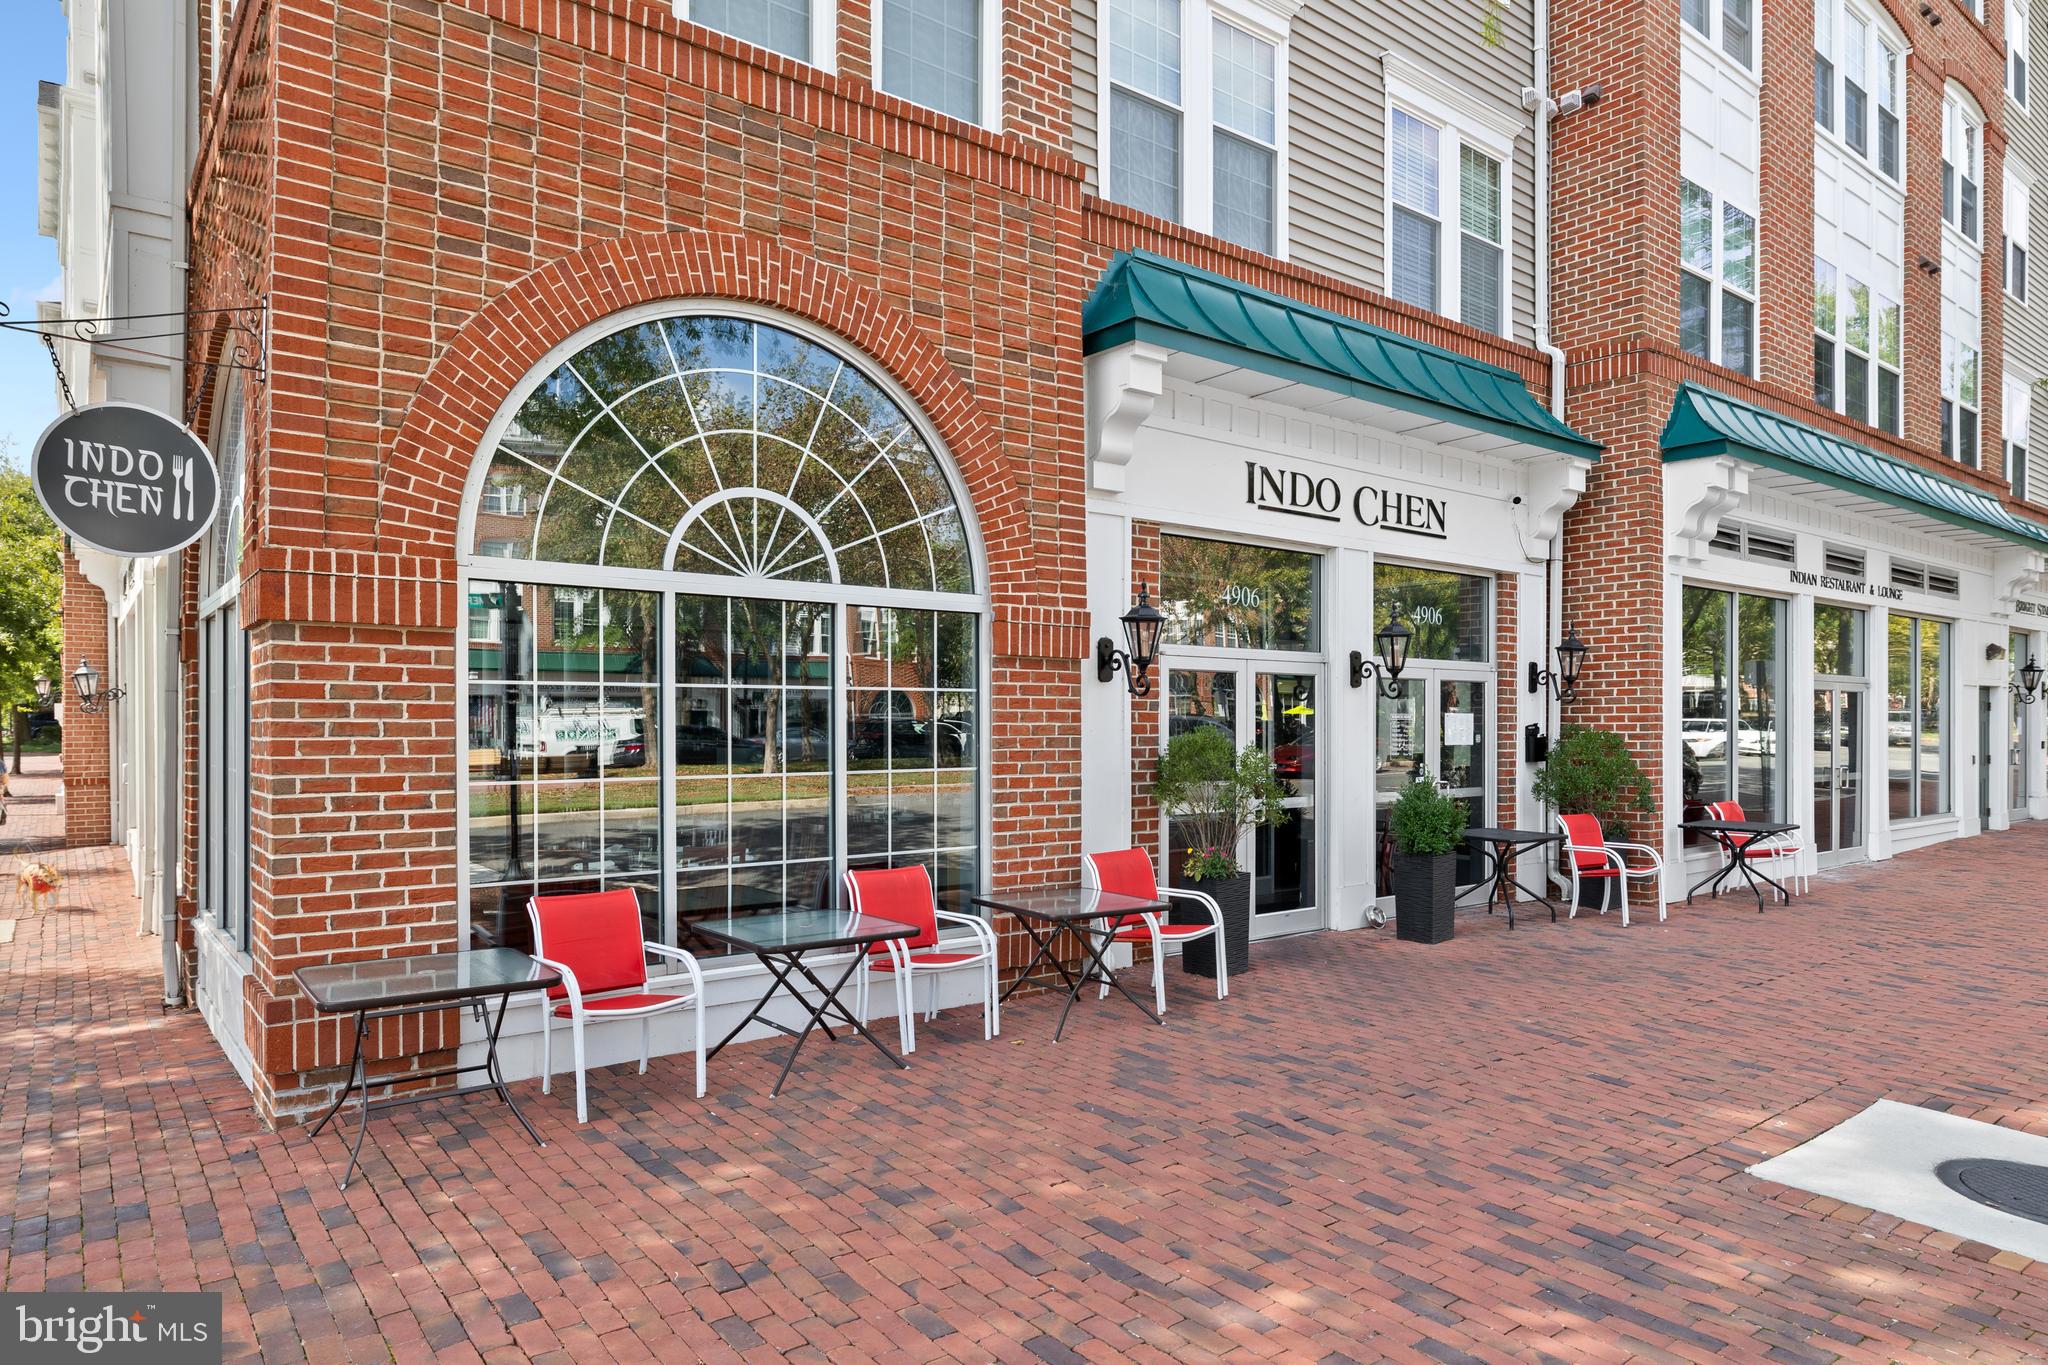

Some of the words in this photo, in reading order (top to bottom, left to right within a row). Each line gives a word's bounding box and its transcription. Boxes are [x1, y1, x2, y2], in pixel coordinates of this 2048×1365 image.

[64, 438, 164, 481] INDO
[64, 474, 164, 518] CHEN
[1245, 461, 1341, 514] INDO
[1353, 486, 1447, 534] CHEN
[1221, 585, 1260, 608] 4906
[1790, 570, 1817, 586] INDIAN
[1820, 575, 1866, 594] RESTAURANT
[1869, 584, 1875, 595] &
[1877, 585, 1904, 601] LOUNGE
[1413, 605, 1443, 626] 4906
